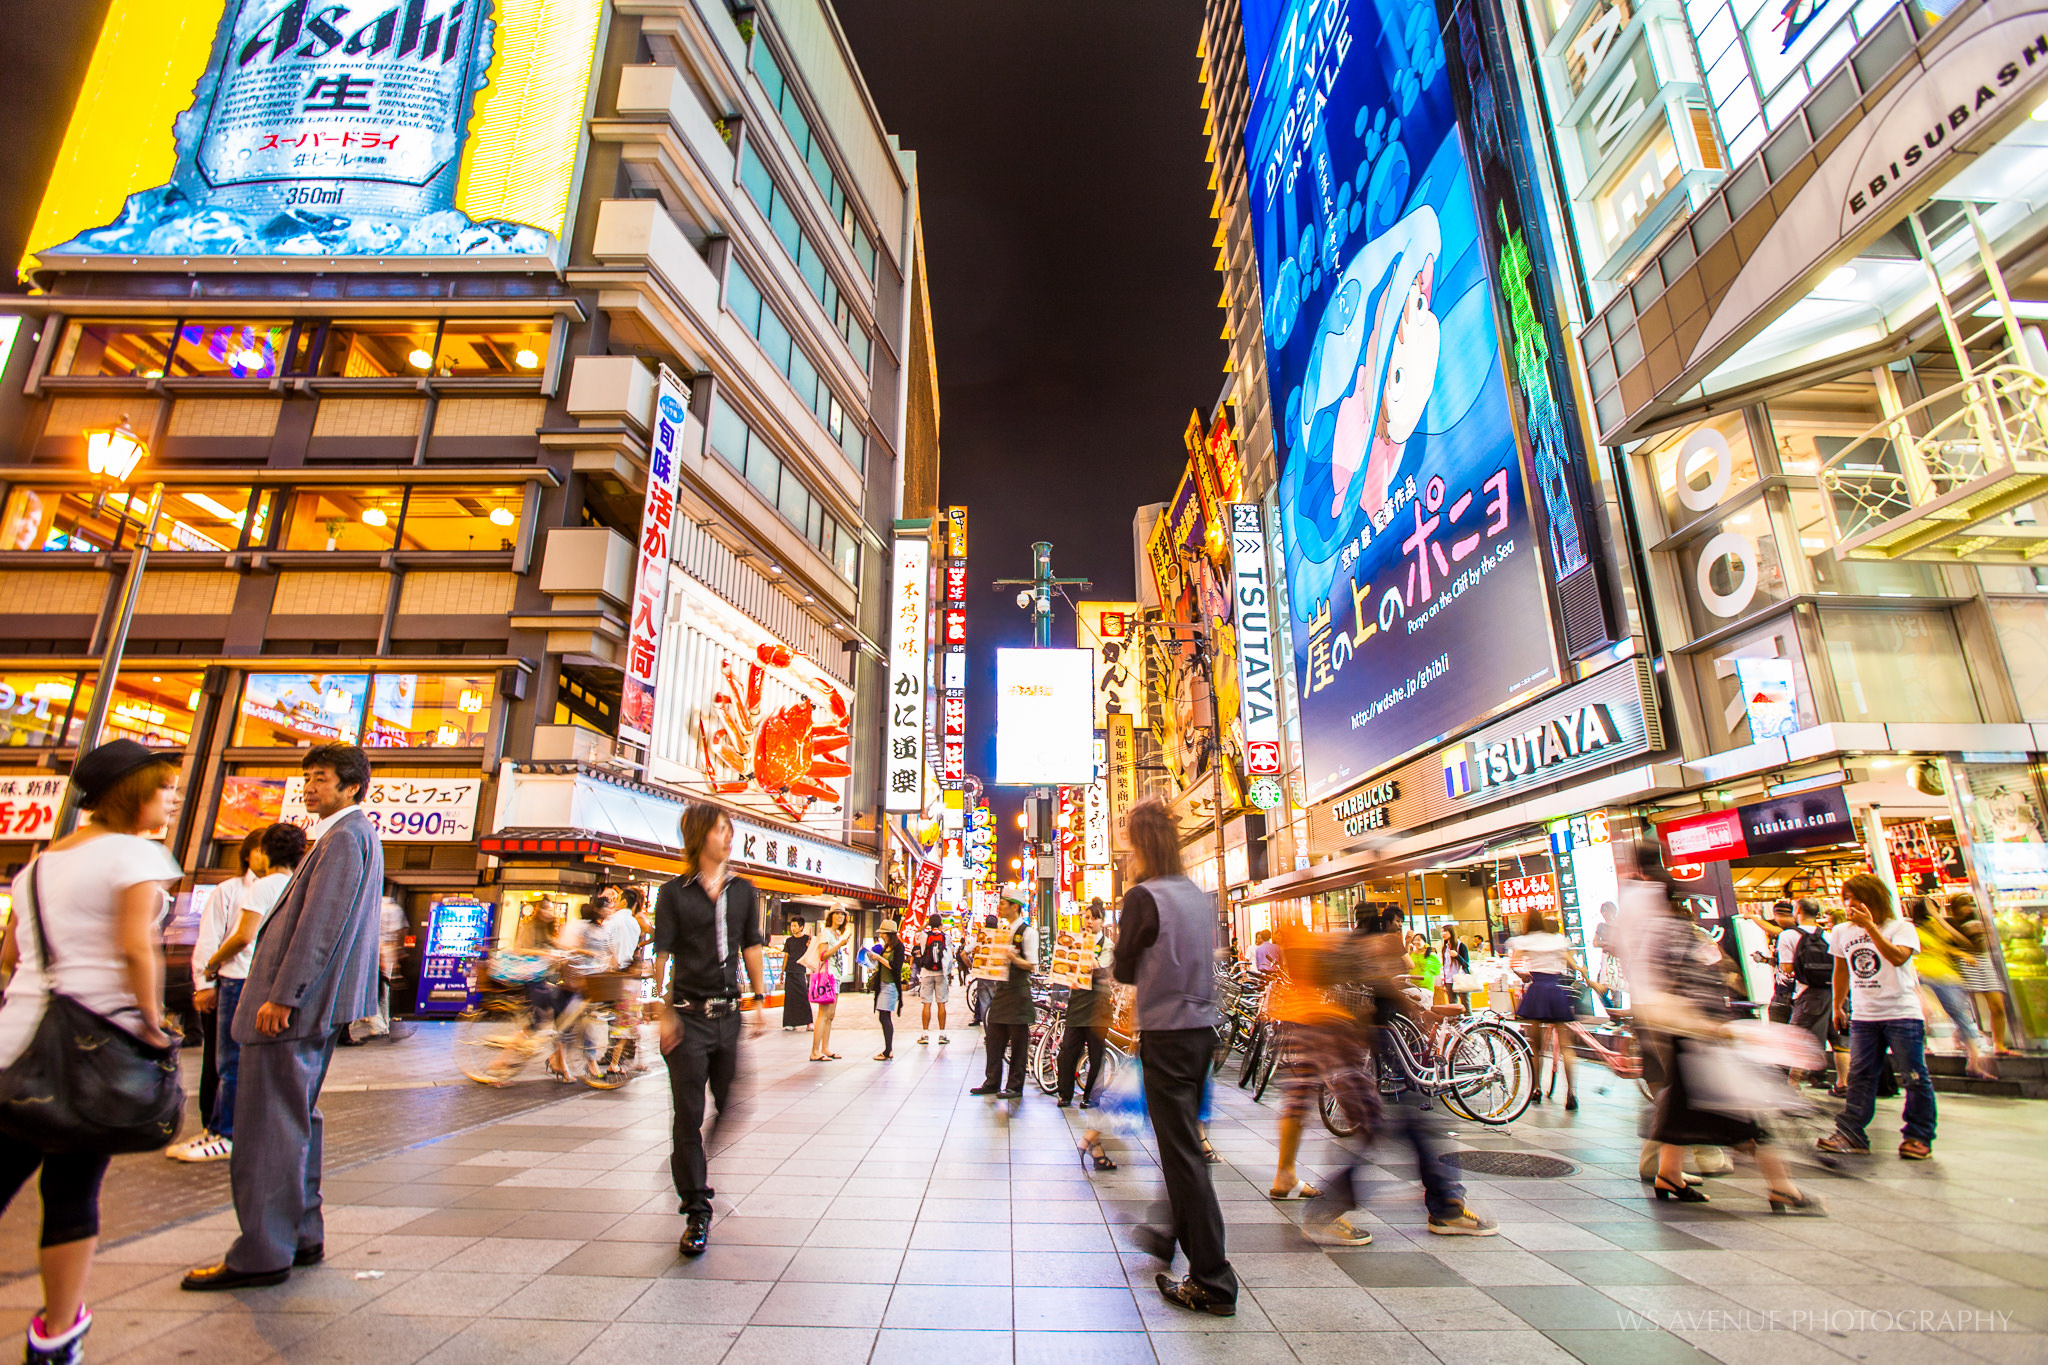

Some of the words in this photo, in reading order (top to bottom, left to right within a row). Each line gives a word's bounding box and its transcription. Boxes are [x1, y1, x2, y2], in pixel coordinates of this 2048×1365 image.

[238, 0, 465, 67] Asahi
[302, 73, 374, 112] 生
[1286, 149, 1302, 194] ON
[1302, 15, 1353, 152] SALE
[258, 131, 400, 151] スーパードライ
[285, 187, 344, 205] 350ml
[1233, 504, 1258, 513] OPEN
[1234, 511, 1259, 526] 24
[1407, 610, 1429, 635] Ponyo
[1428, 603, 1440, 619] on
[1438, 592, 1453, 610] the
[1451, 571, 1469, 598] Cliff
[1468, 567, 1481, 586] by
[1480, 555, 1496, 575] the
[1495, 539, 1515, 562] Sea
[898, 579, 920, 657] 本場の味
[1238, 567, 1275, 725] TSUTAYA
[1350, 652, 1450, 731] http://wdshe.jp/ghibli
[1473, 703, 1614, 788] TSUTAYA
[1332, 780, 1395, 821] STARBUCKS
[1344, 807, 1384, 837] COFFEE
[1941, 846, 1958, 865] 2
[1503, 875, 1550, 897] もやしもん
